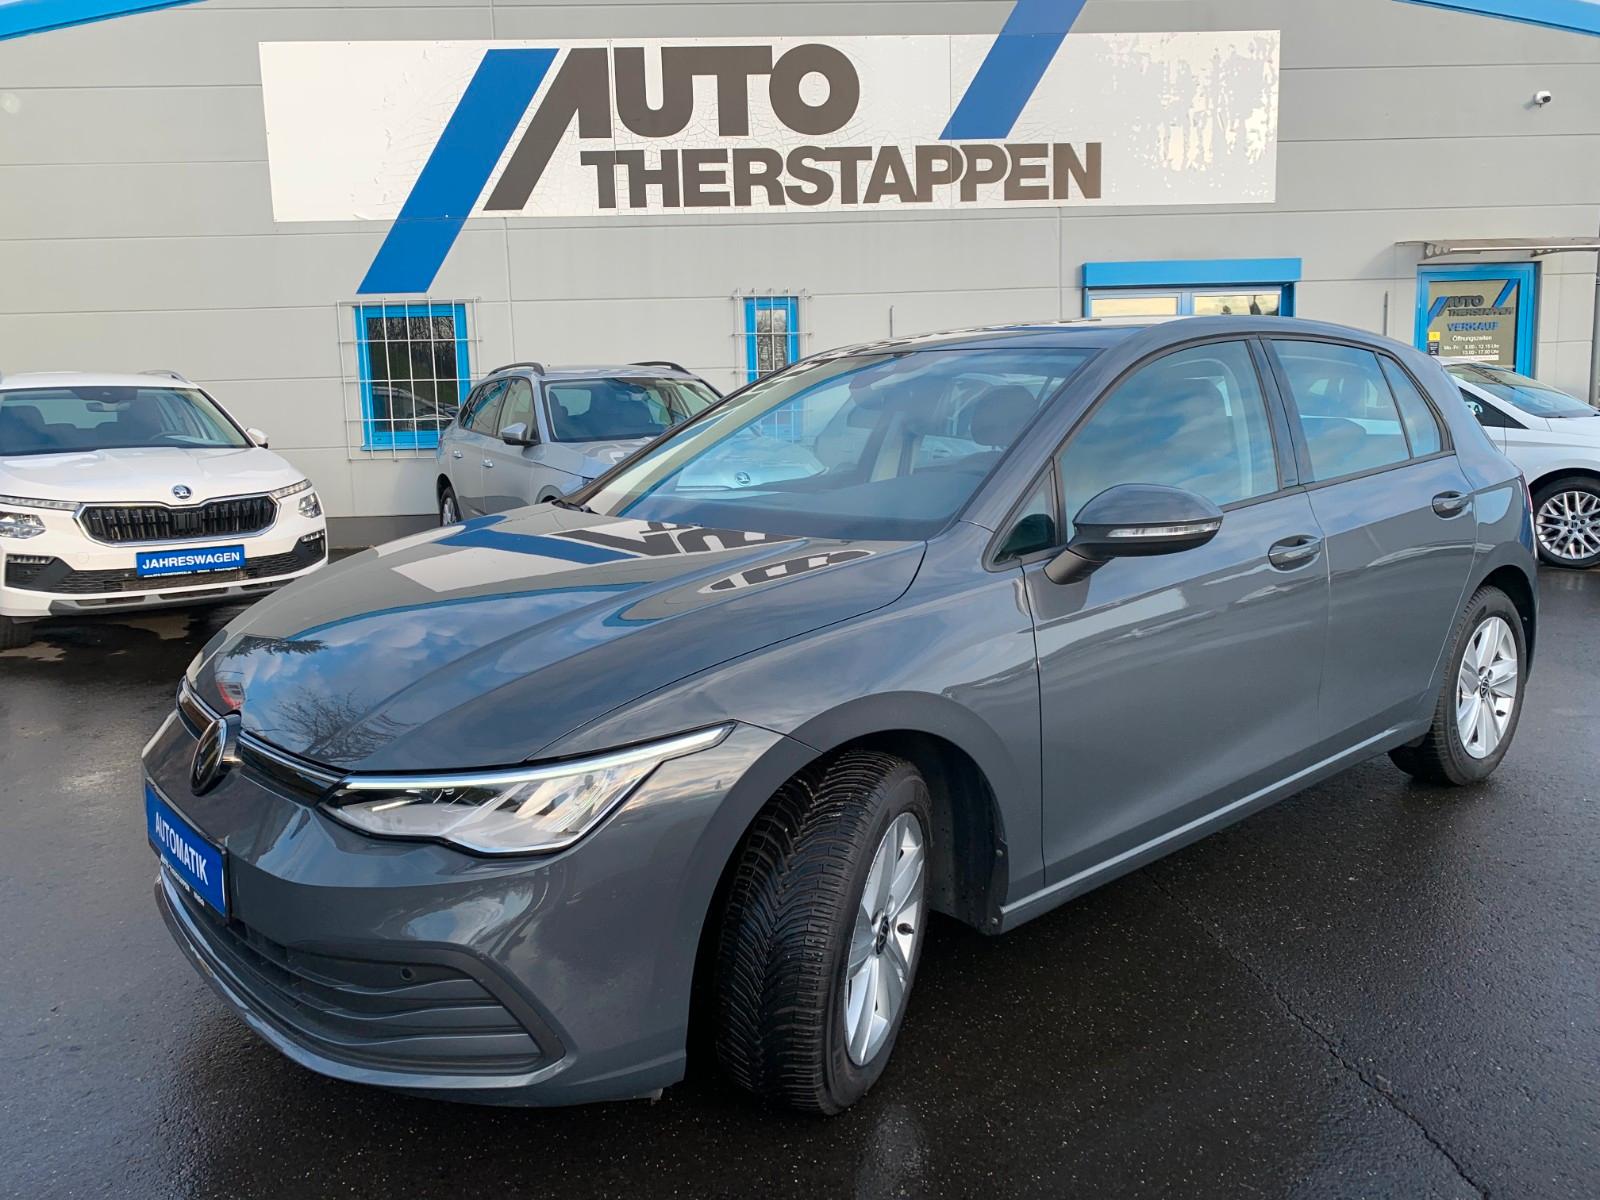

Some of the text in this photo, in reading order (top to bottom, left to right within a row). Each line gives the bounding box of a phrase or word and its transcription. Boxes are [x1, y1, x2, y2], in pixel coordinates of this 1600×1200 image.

[483, 43, 860, 211] AUTO
[580, 141, 1102, 209] THERSTAPPEN
[1447, 321, 1499, 331] VERKAUF
[142, 552, 240, 570] JAHRESWAGEN
[155, 811, 209, 886] AUTOMATIK
